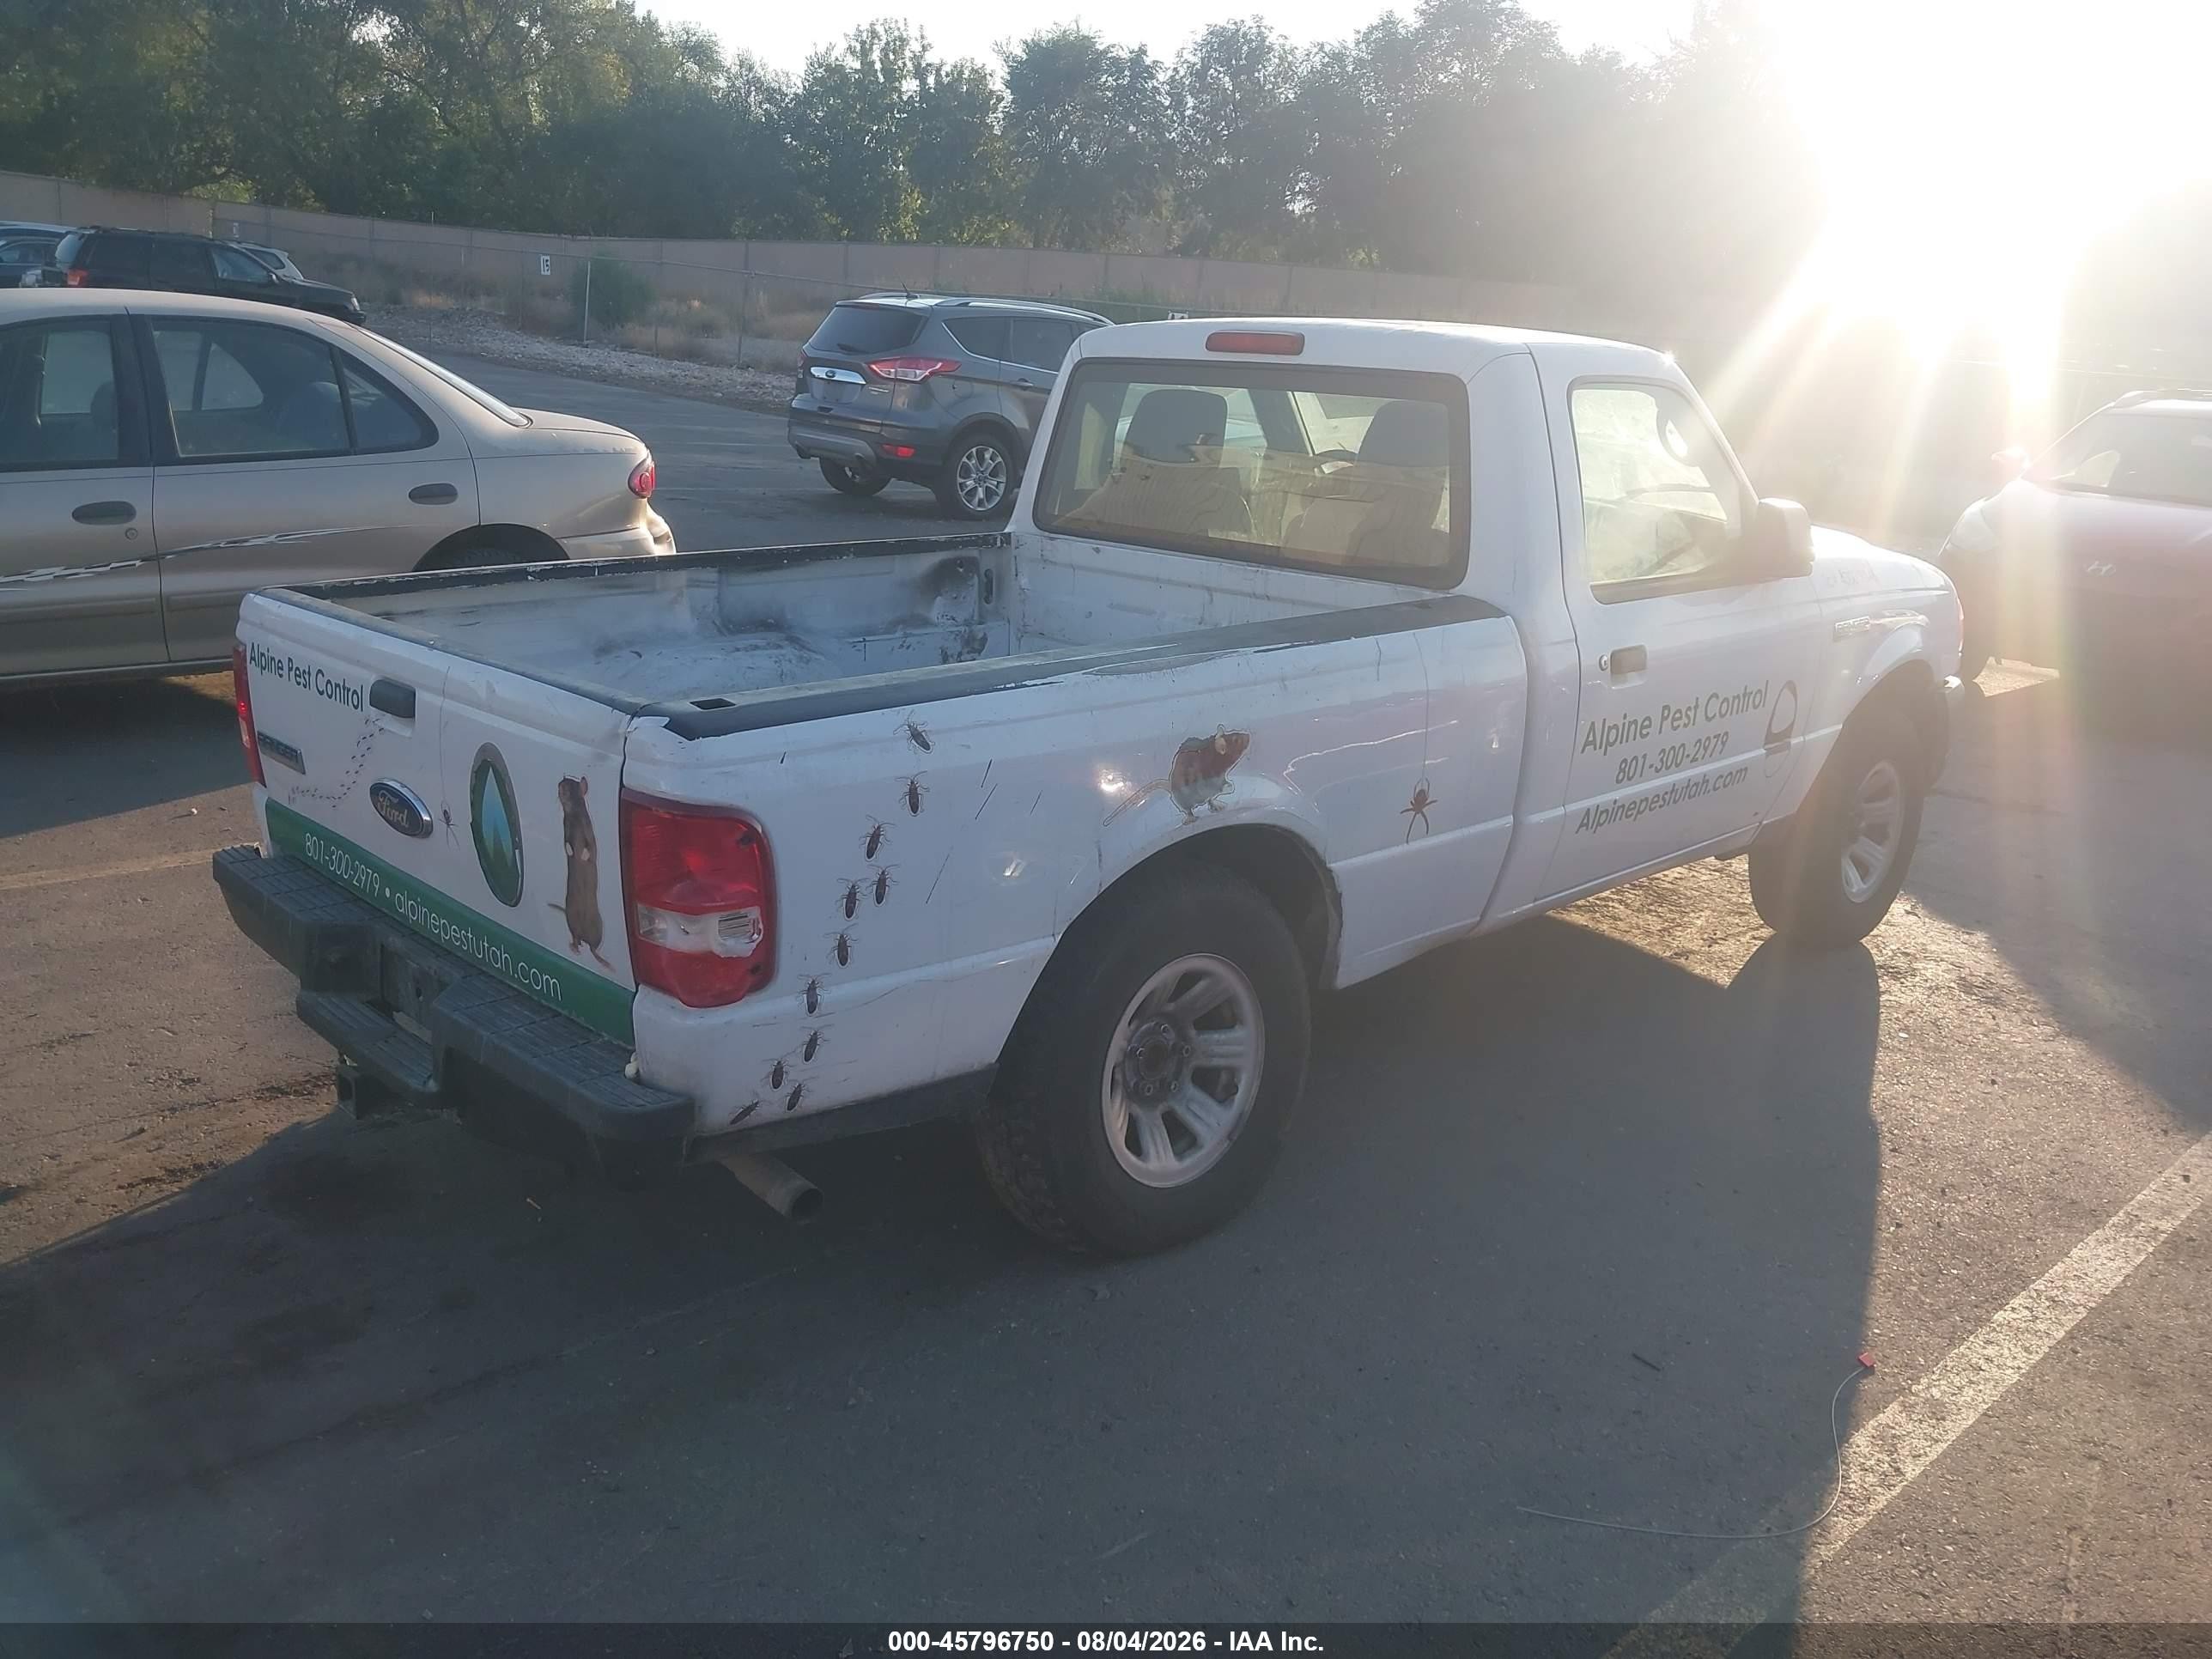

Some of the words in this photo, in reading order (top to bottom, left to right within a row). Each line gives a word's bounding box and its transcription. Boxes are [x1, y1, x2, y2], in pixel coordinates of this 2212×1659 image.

[249, 642, 284, 679] Alpine
[288, 656, 313, 690] Pest
[314, 669, 364, 712] Control
[1580, 712, 1652, 756] Alpine
[1658, 696, 1699, 735] Pest
[1705, 680, 1769, 720] Control
[1615, 731, 1729, 785] 801-300-2979
[377, 790, 409, 828] Ford
[1576, 766, 1748, 835] Alpinepestutah.com
[305, 831, 380, 899] 801-300-2979
[395, 890, 562, 1001] alpinepestutah.com
